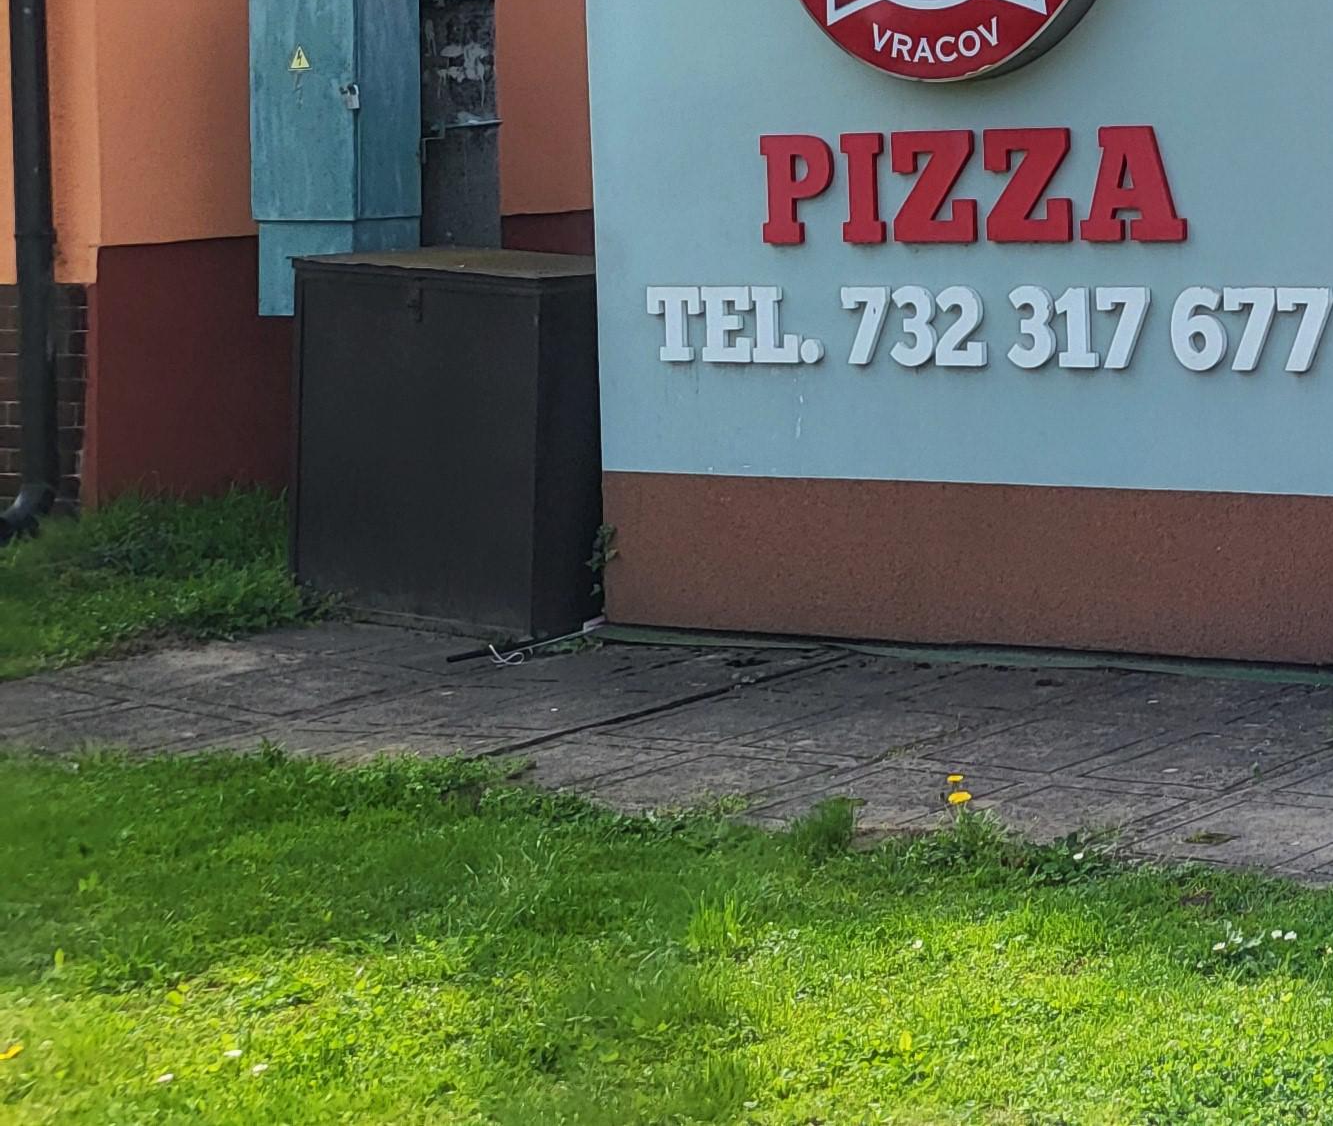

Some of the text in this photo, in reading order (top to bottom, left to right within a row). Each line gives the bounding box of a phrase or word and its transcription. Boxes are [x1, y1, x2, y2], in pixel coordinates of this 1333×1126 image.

[872, 18, 998, 63] VRACOV
[759, 125, 1188, 244] PIZZA
[647, 285, 1333, 372] TEL. 732 317 677
